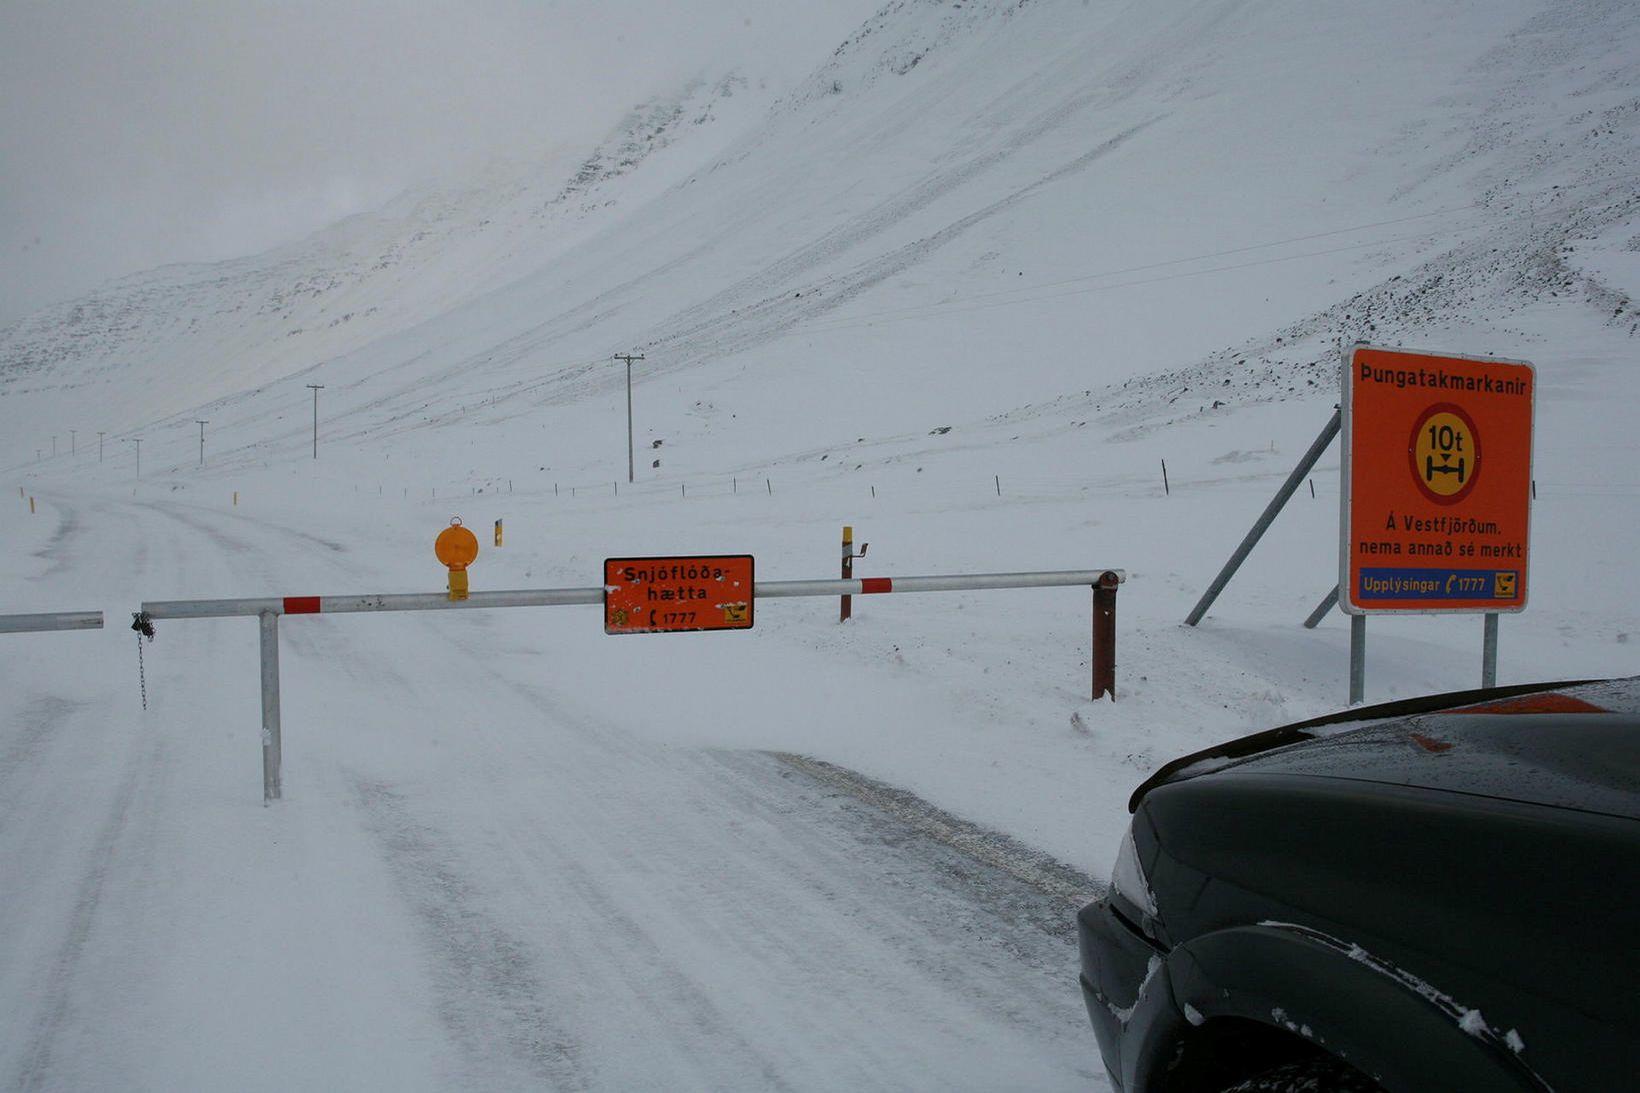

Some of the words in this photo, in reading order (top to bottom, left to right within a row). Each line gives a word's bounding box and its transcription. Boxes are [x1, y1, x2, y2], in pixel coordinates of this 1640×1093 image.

[1361, 363, 1527, 395] Þungatakmarkanir
[1386, 511, 1396, 530] Á
[1360, 541, 1401, 554] nema
[1408, 540, 1453, 556] annað
[1459, 541, 1475, 557] sé
[1481, 542, 1521, 558] merkt
[625, 566, 730, 582] Snjóflóða-
[1364, 576, 1440, 593] Upplýsingar
[1459, 577, 1486, 590] 1777
[648, 587, 707, 601] hætta
[664, 613, 696, 624] 1777
